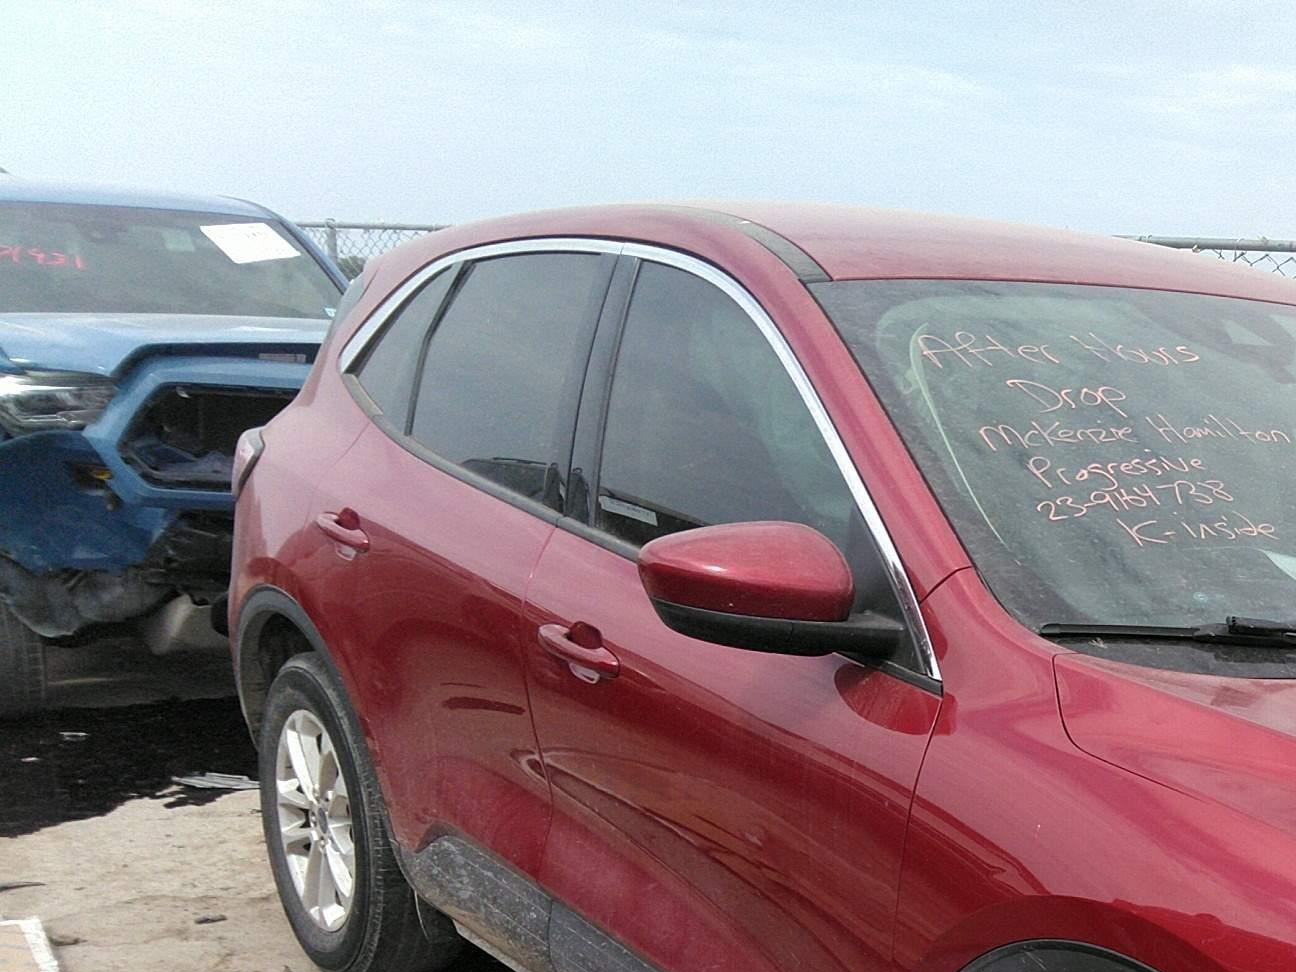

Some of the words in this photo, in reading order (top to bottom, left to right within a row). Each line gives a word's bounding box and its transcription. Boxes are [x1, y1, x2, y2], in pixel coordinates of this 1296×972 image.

[917, 331, 1060, 368] After
[1069, 332, 1200, 366] Hours
[1005, 379, 1129, 419] Drop
[979, 420, 1138, 452] McKenzie
[1145, 413, 1292, 444] Hamilton
[1025, 454, 1208, 491] Progressive
